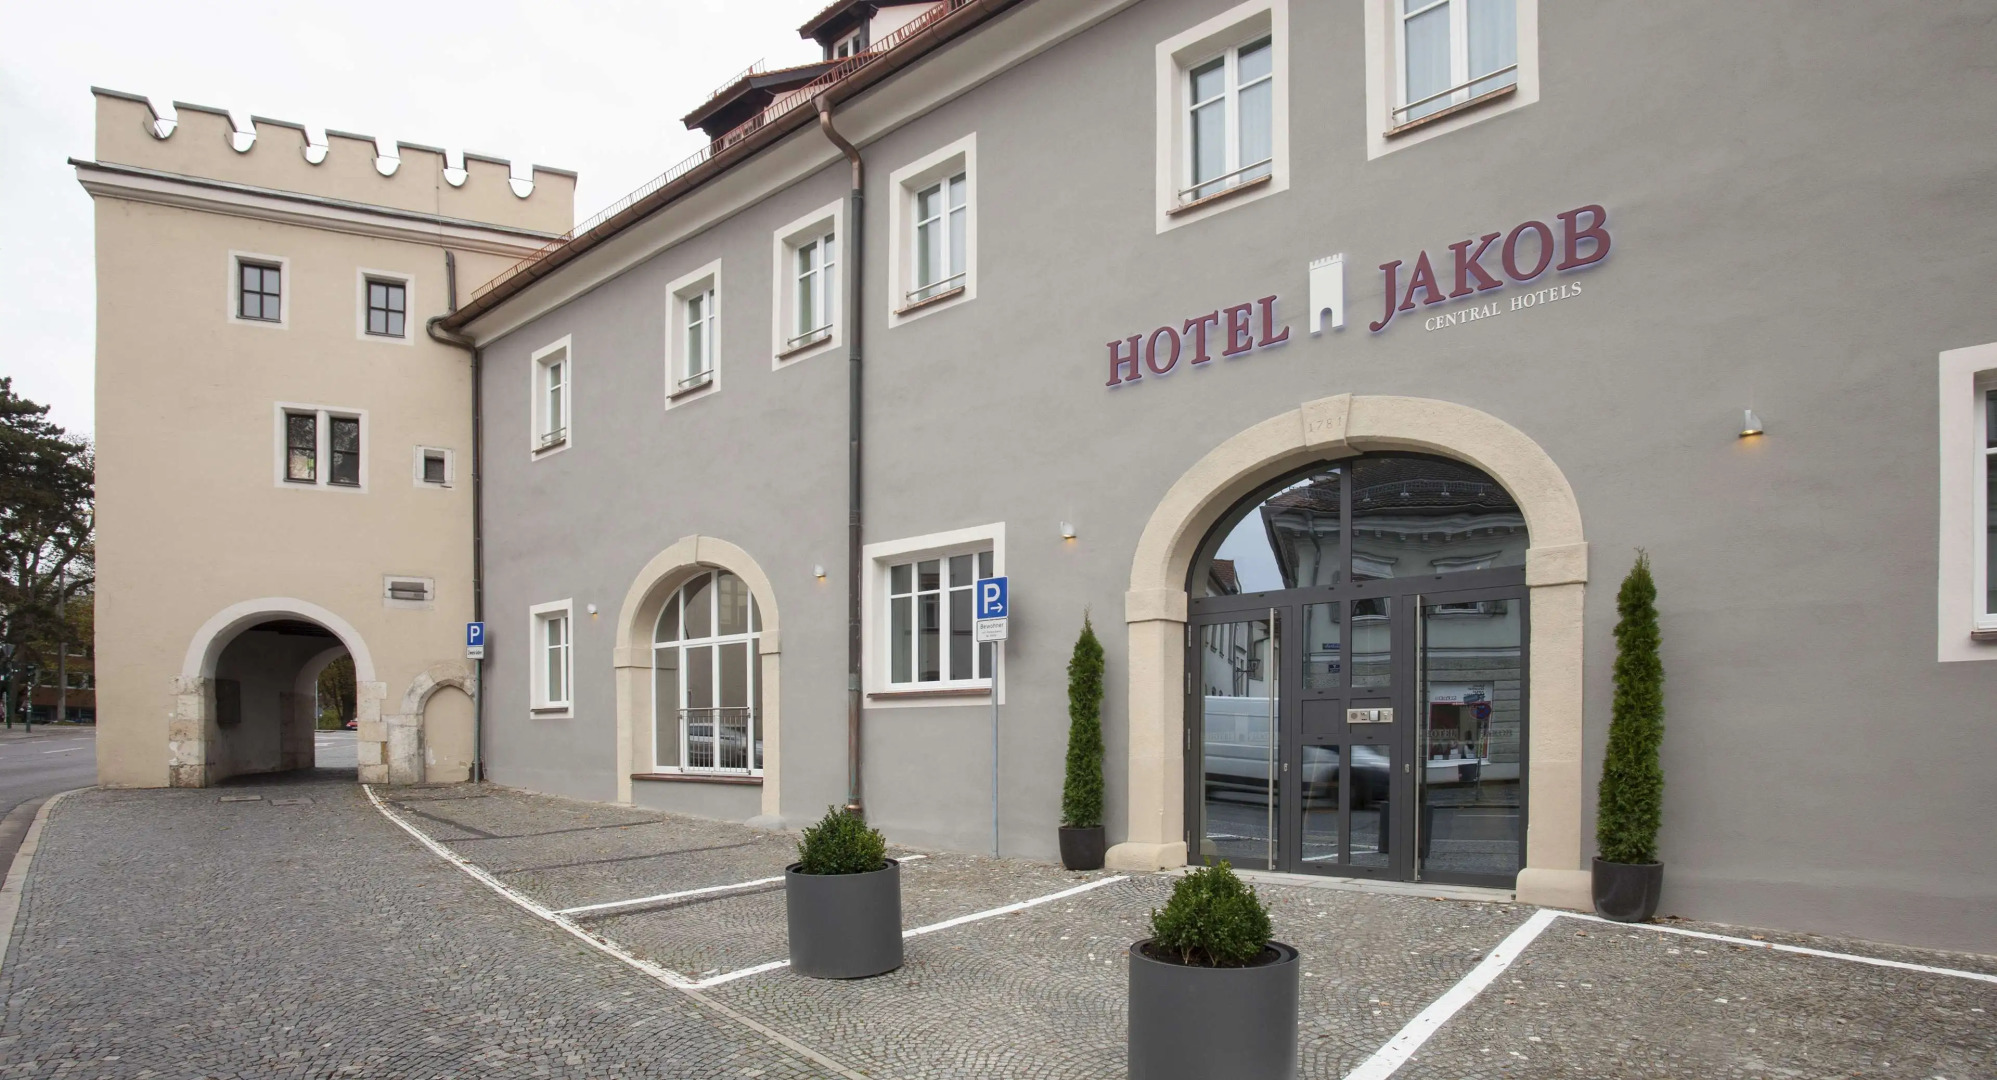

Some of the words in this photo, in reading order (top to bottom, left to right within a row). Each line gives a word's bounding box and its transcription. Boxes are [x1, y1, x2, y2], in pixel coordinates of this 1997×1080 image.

[1105, 294, 1290, 387] HOTEL
[1368, 204, 1612, 332] JAKOB
[1425, 302, 1501, 332] CENTRAL
[1510, 281, 1582, 312] HOTELS
[1309, 416, 1342, 433] 1781
[983, 583, 1001, 614] P
[470, 625, 481, 643] P
